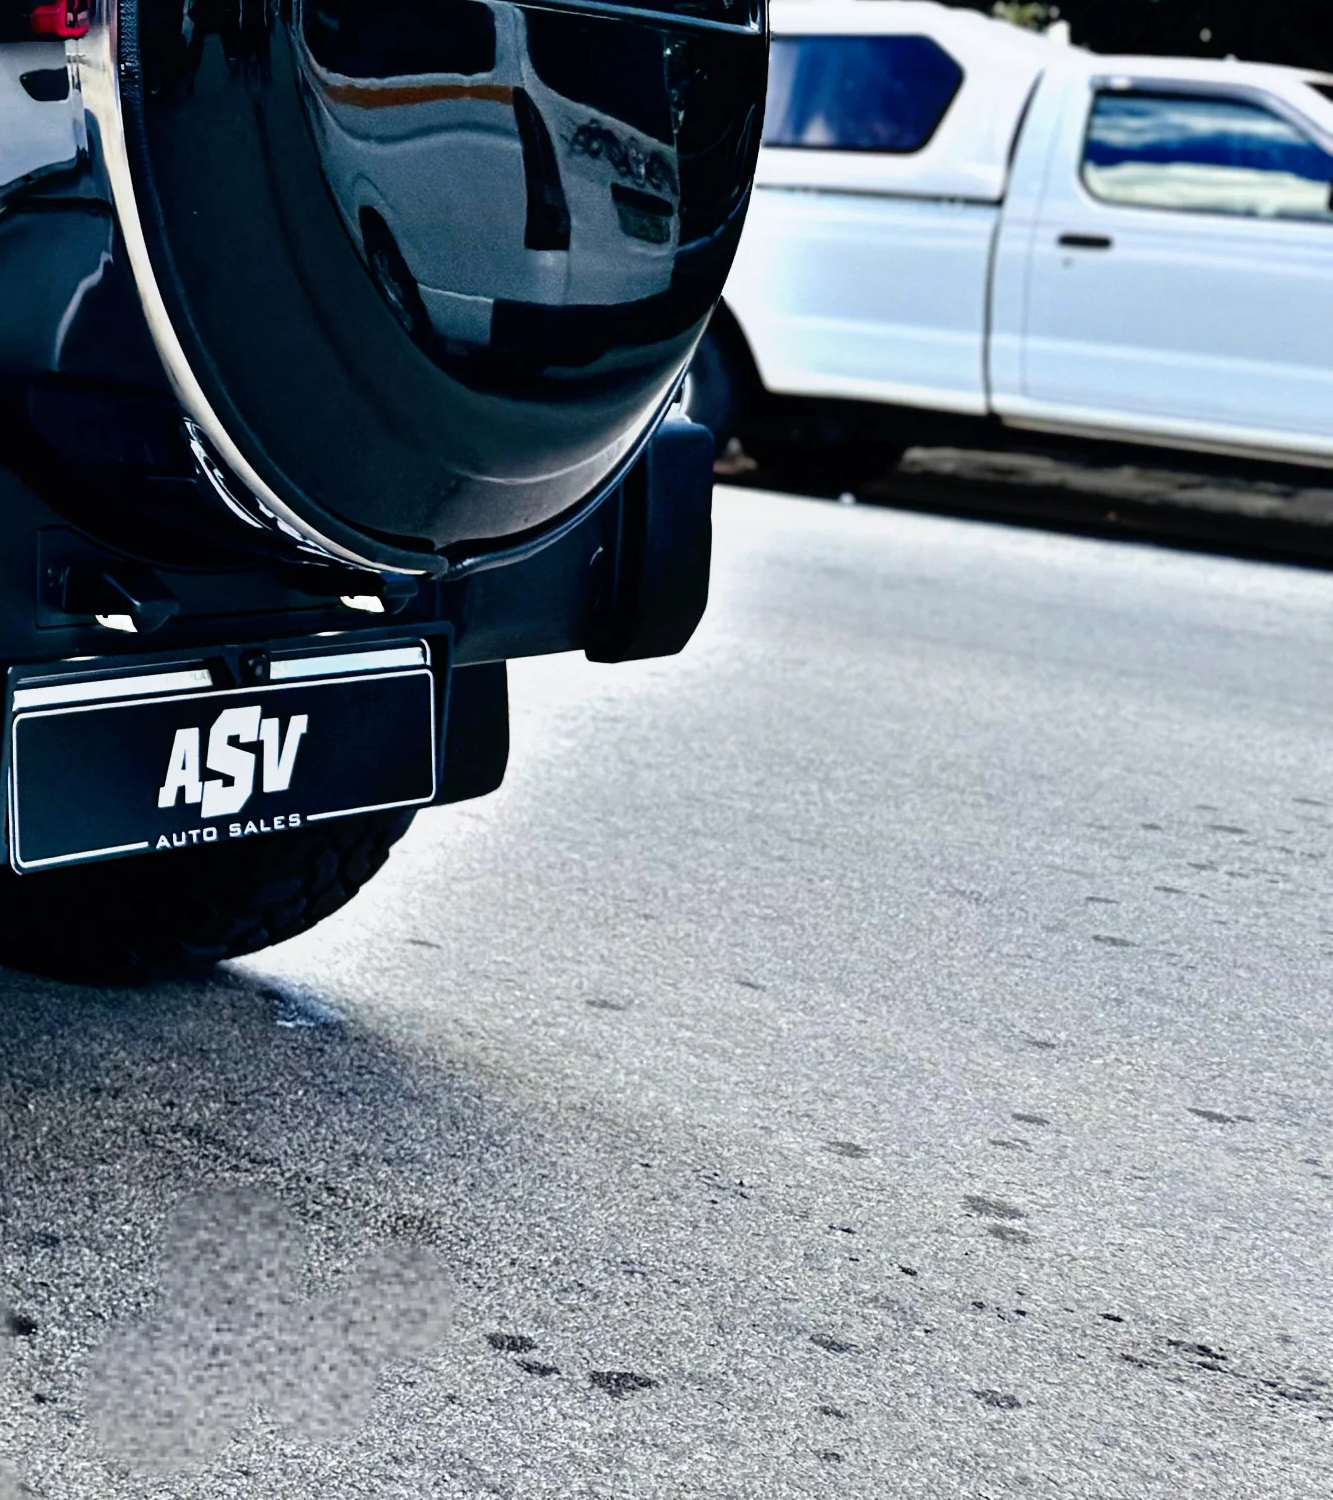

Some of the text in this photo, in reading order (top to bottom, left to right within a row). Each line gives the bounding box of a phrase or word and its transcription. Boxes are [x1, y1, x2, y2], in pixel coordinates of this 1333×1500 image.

[158, 705, 308, 819] ASV
[155, 813, 303, 850] AUTO SALES
